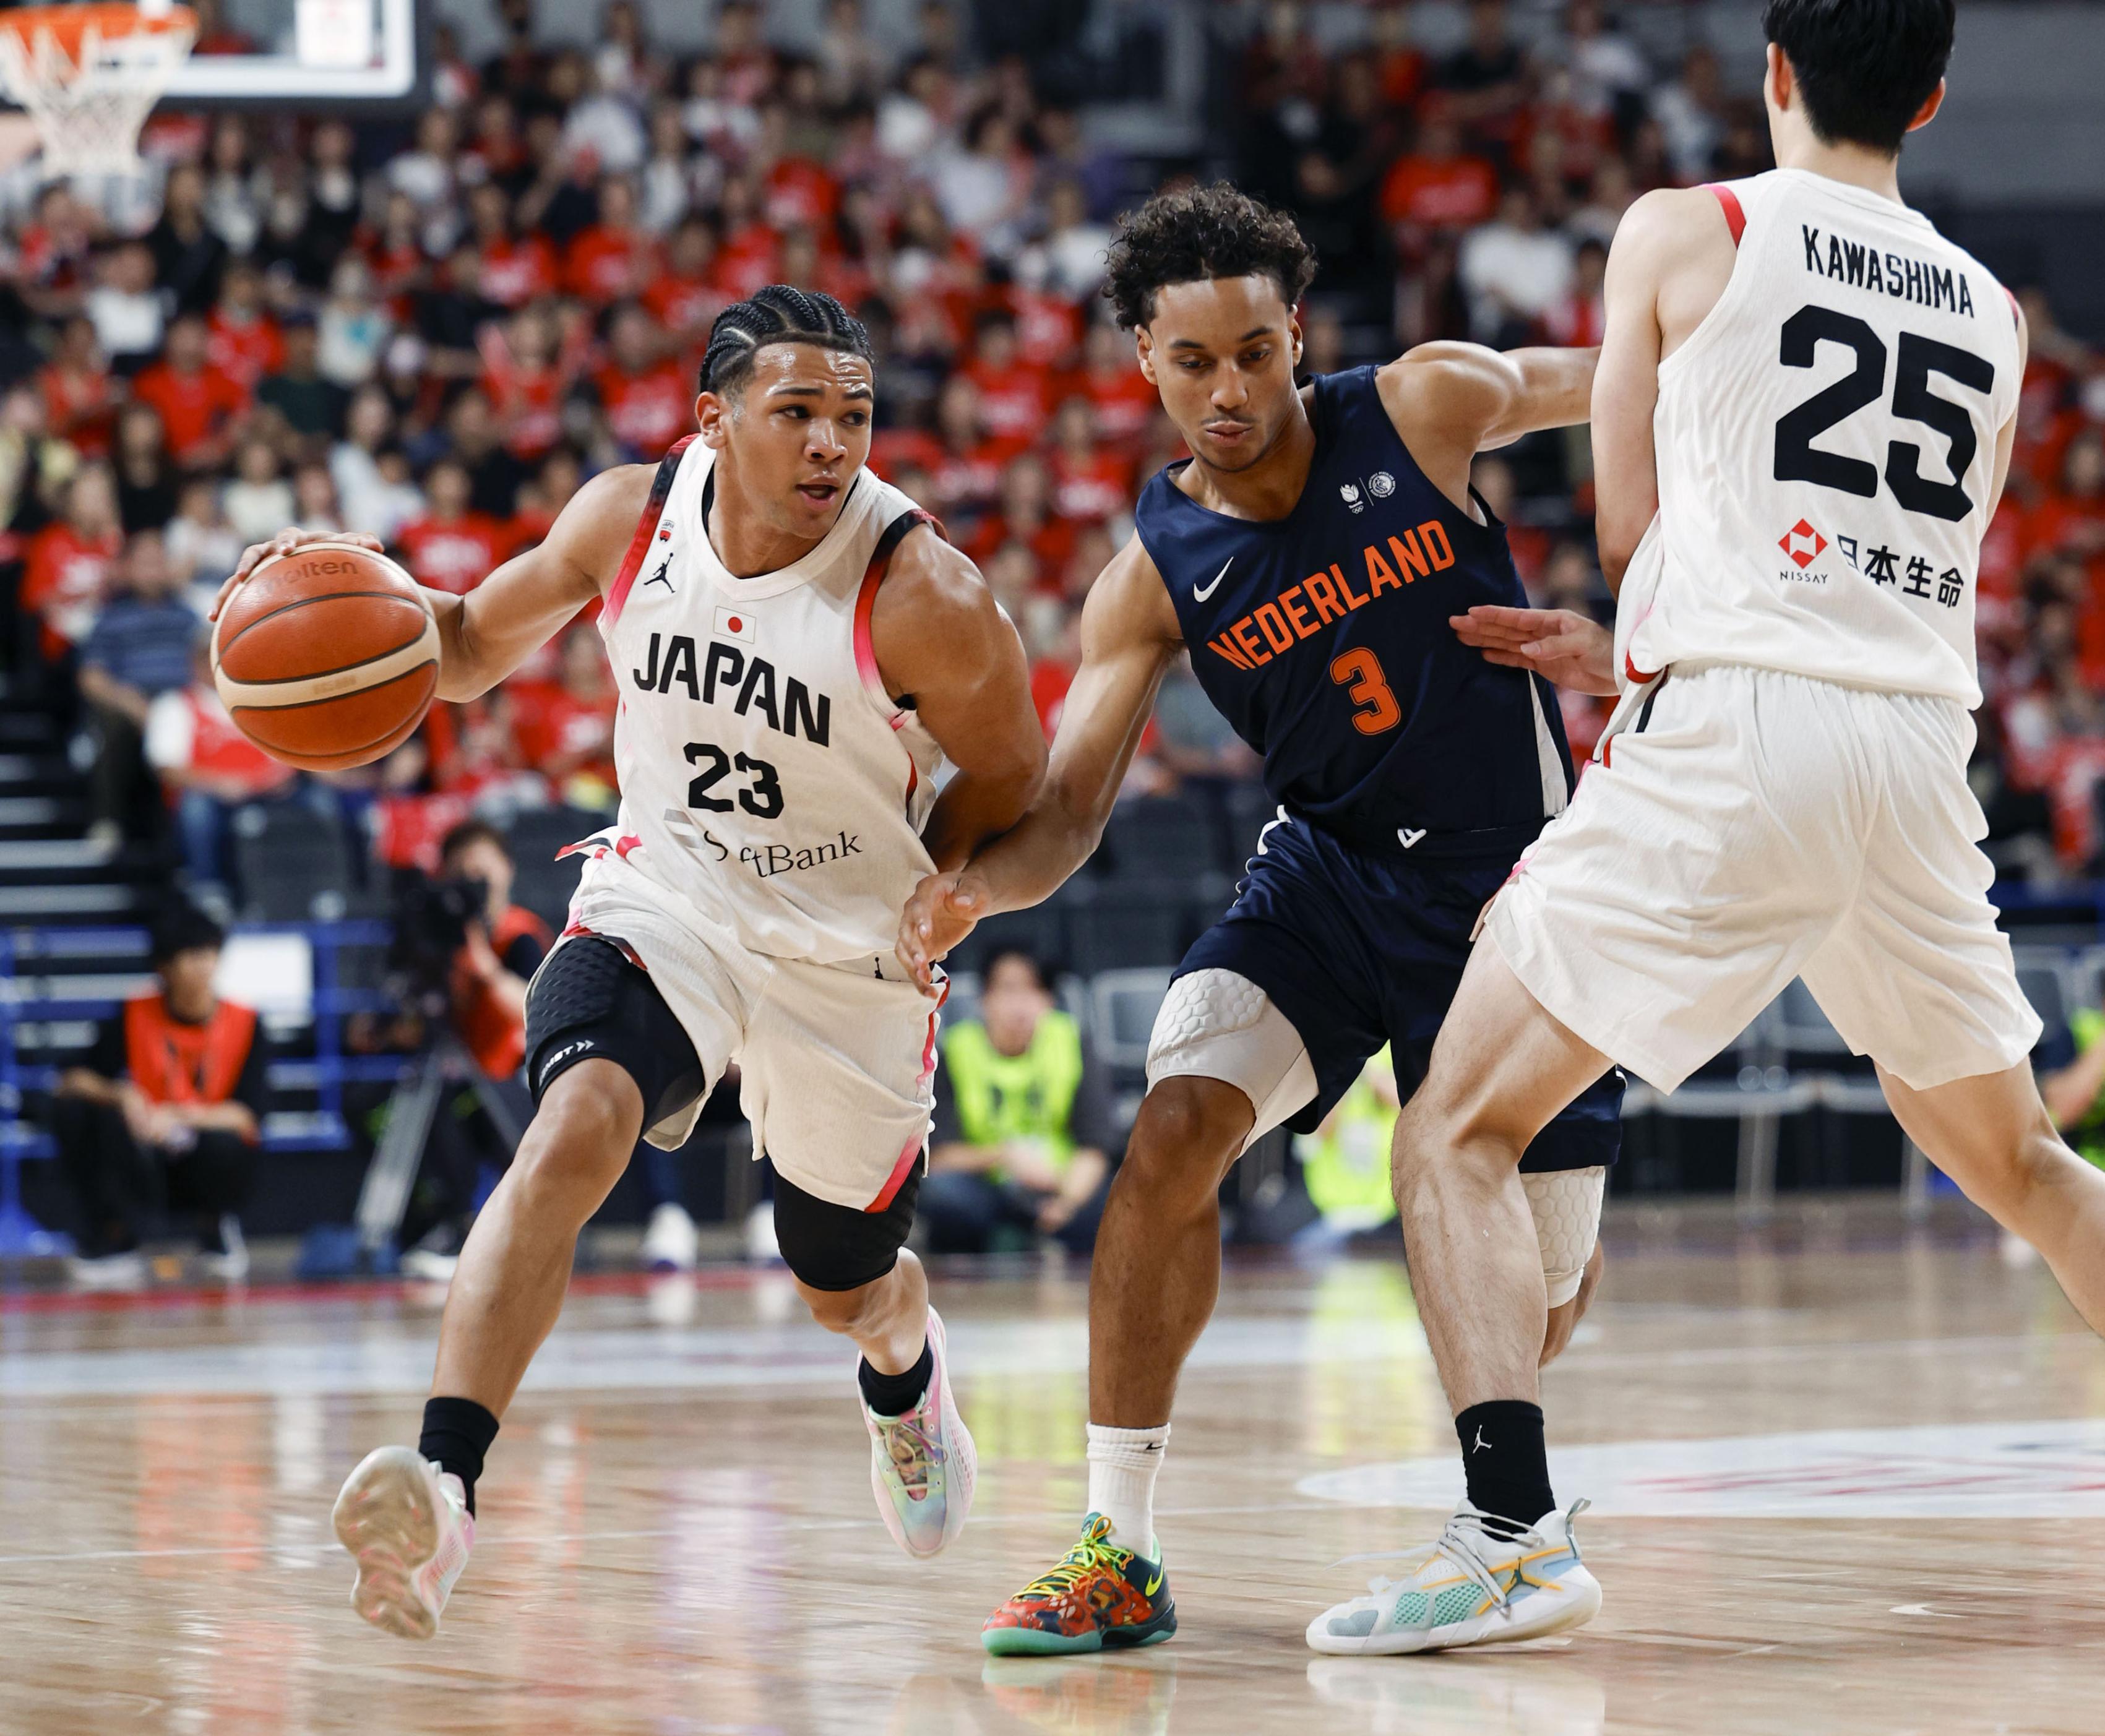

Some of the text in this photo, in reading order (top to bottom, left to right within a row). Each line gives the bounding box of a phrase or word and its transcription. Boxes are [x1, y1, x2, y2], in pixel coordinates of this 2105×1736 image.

[1802, 225, 1974, 318] KAWASHIMA
[1773, 304, 1995, 522] 25
[1207, 520, 1455, 670] NEDERLAND
[1780, 570, 1828, 584] NISSAY
[1836, 534, 1965, 608] 日本生命
[633, 632, 830, 748] JAPAN
[1330, 647, 1401, 736] 3
[683, 742, 785, 820] 23
[704, 830, 863, 877] SftBank
